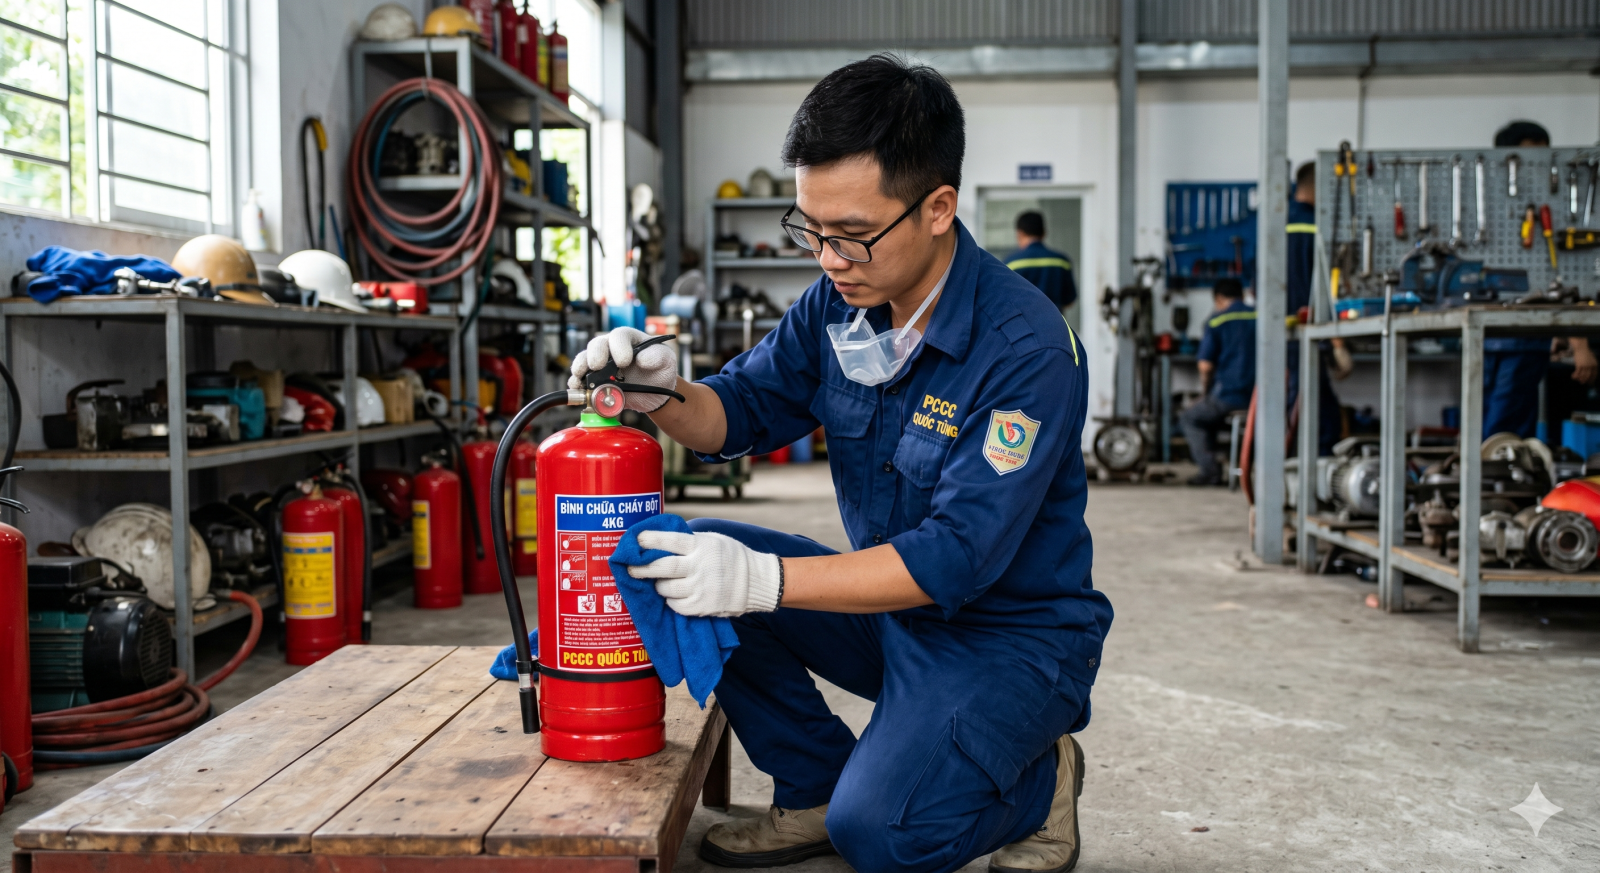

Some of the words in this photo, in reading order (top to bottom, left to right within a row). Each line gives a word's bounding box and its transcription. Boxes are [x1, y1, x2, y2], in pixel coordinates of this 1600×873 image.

[922, 394, 958, 419] PCCC
[560, 500, 584, 515] BÌNH
[586, 501, 616, 515] CHỮA
[618, 499, 644, 514] CHÁY
[645, 497, 659, 514] BỘT
[602, 516, 624, 529] 4KG
[563, 652, 593, 666] PCCC
[597, 647, 630, 667] QUỐC
[632, 647, 650, 663] TÙN
